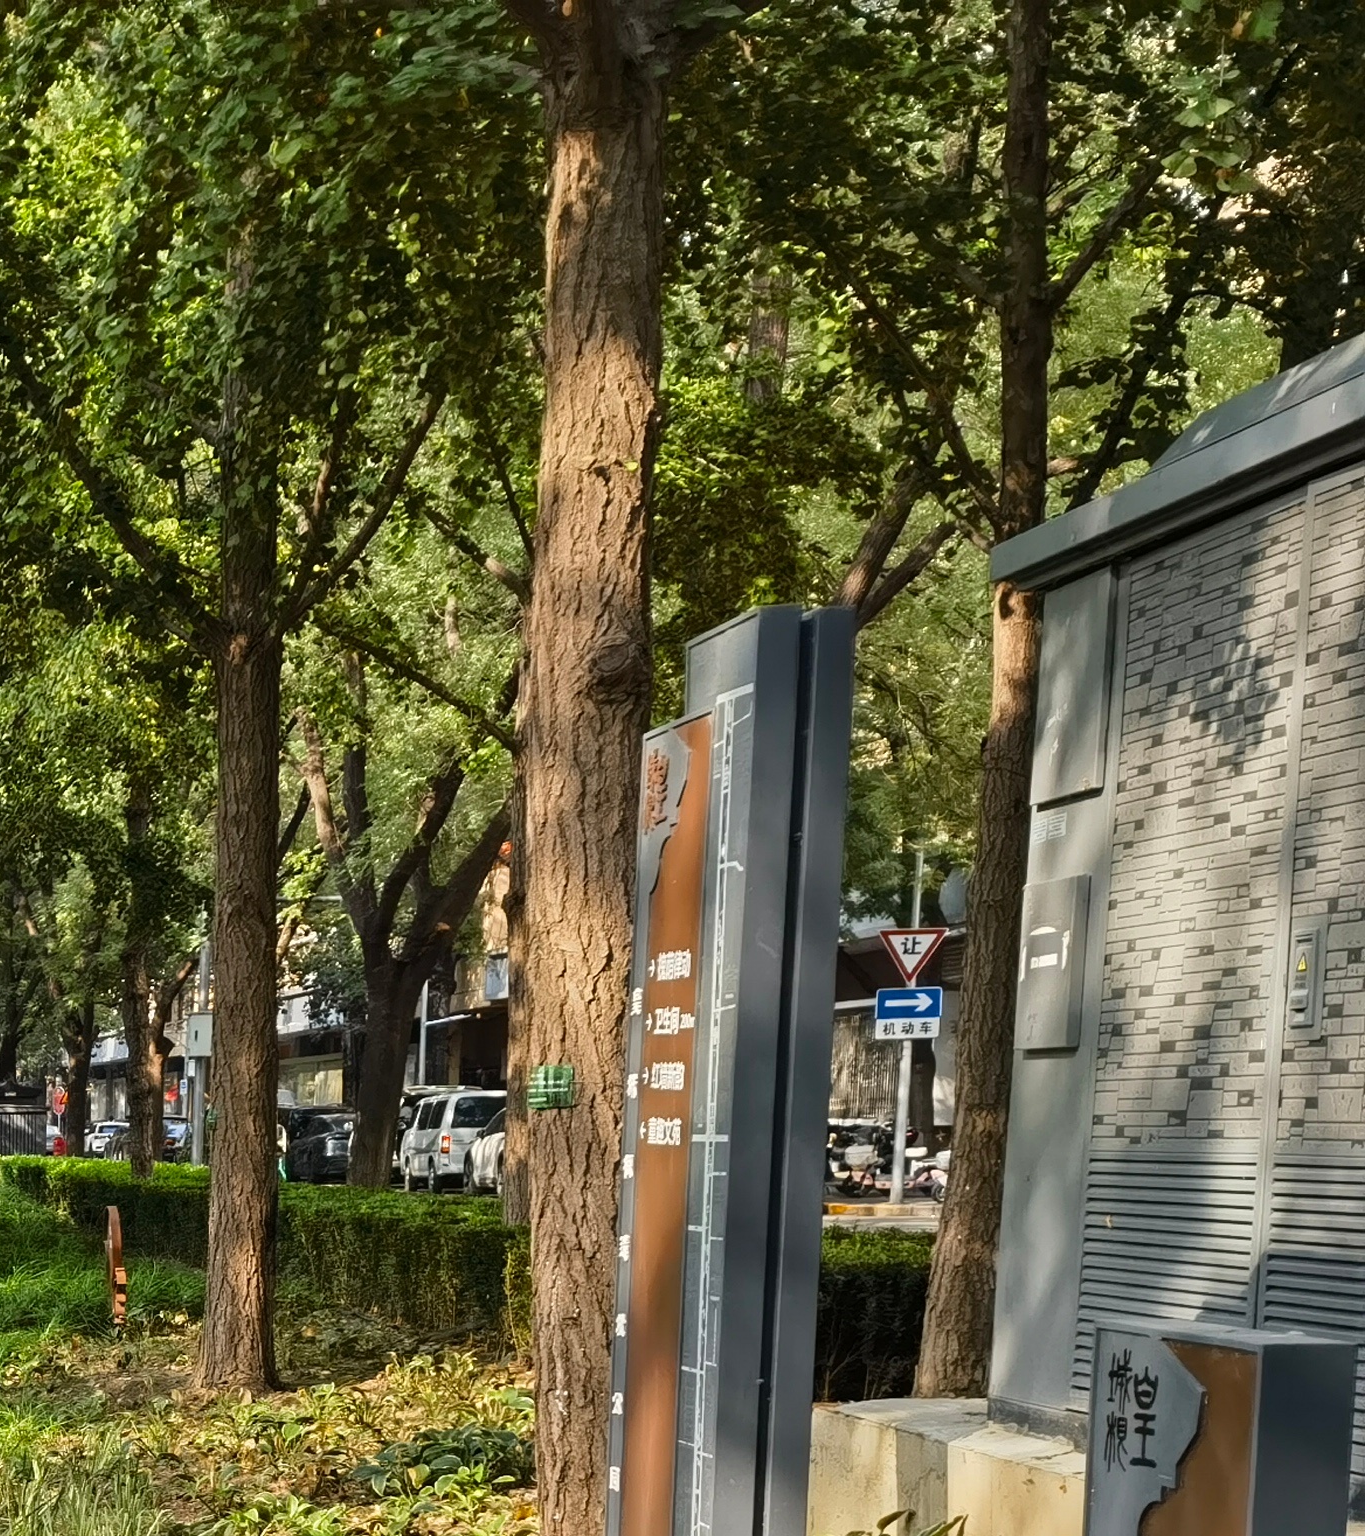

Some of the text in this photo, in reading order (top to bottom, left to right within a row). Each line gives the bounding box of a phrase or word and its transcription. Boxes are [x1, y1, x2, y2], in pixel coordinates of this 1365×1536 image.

[900, 936, 922, 955] 让
[653, 1006, 681, 1035] 卫生间
[882, 1022, 933, 1036] 机动车
